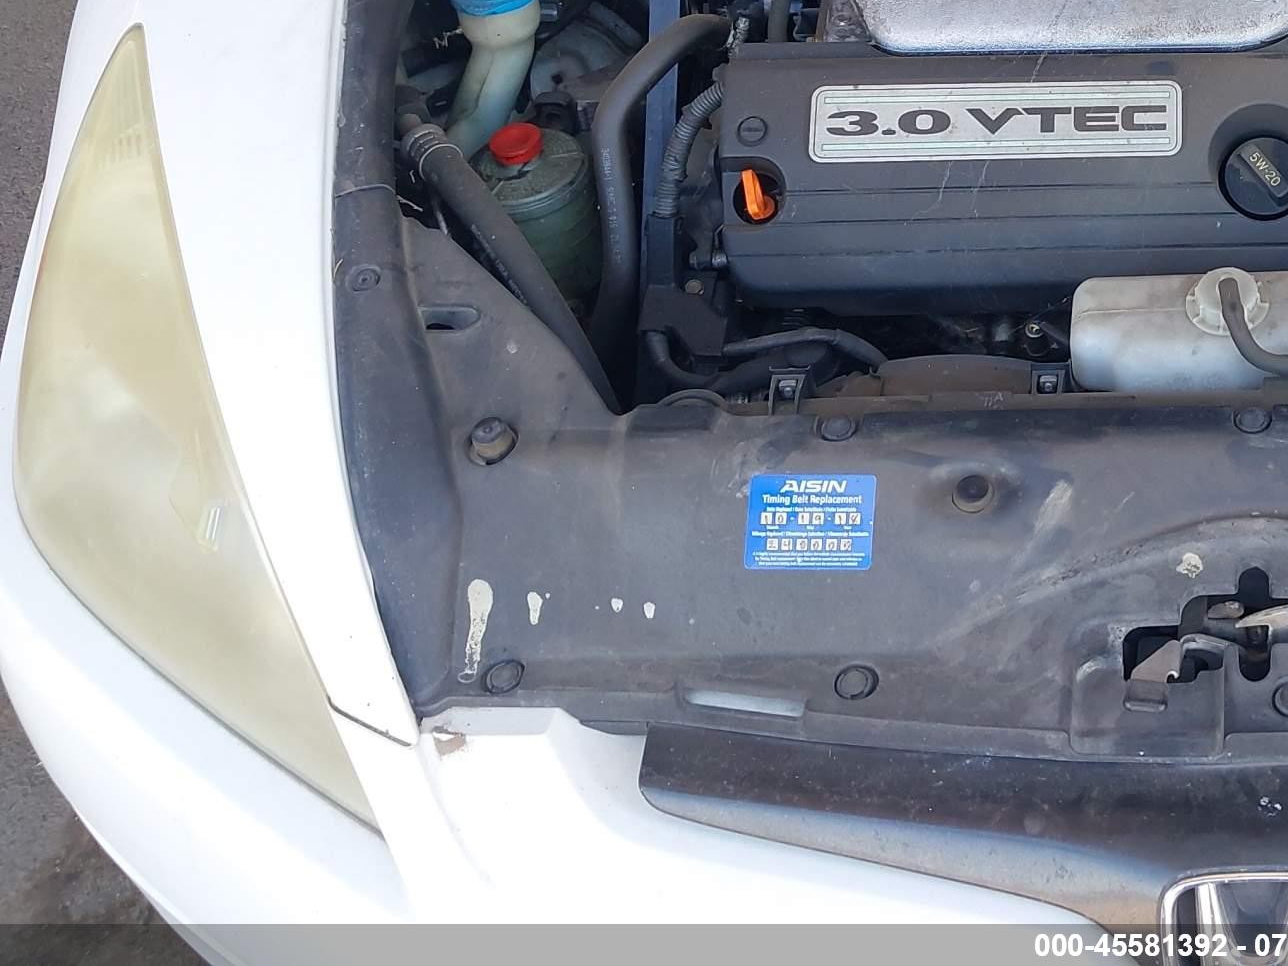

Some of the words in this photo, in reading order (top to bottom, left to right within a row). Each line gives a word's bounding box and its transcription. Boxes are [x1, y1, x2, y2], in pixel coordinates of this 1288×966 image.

[826, 109, 952, 137] 3.0
[965, 105, 1168, 135] VTEC
[1249, 152, 1281, 186] 5W-20
[780, 480, 847, 494] AISIN
[762, 494, 791, 506] Timing
[792, 494, 809, 504] Belt
[810, 494, 862, 506] Replacement
